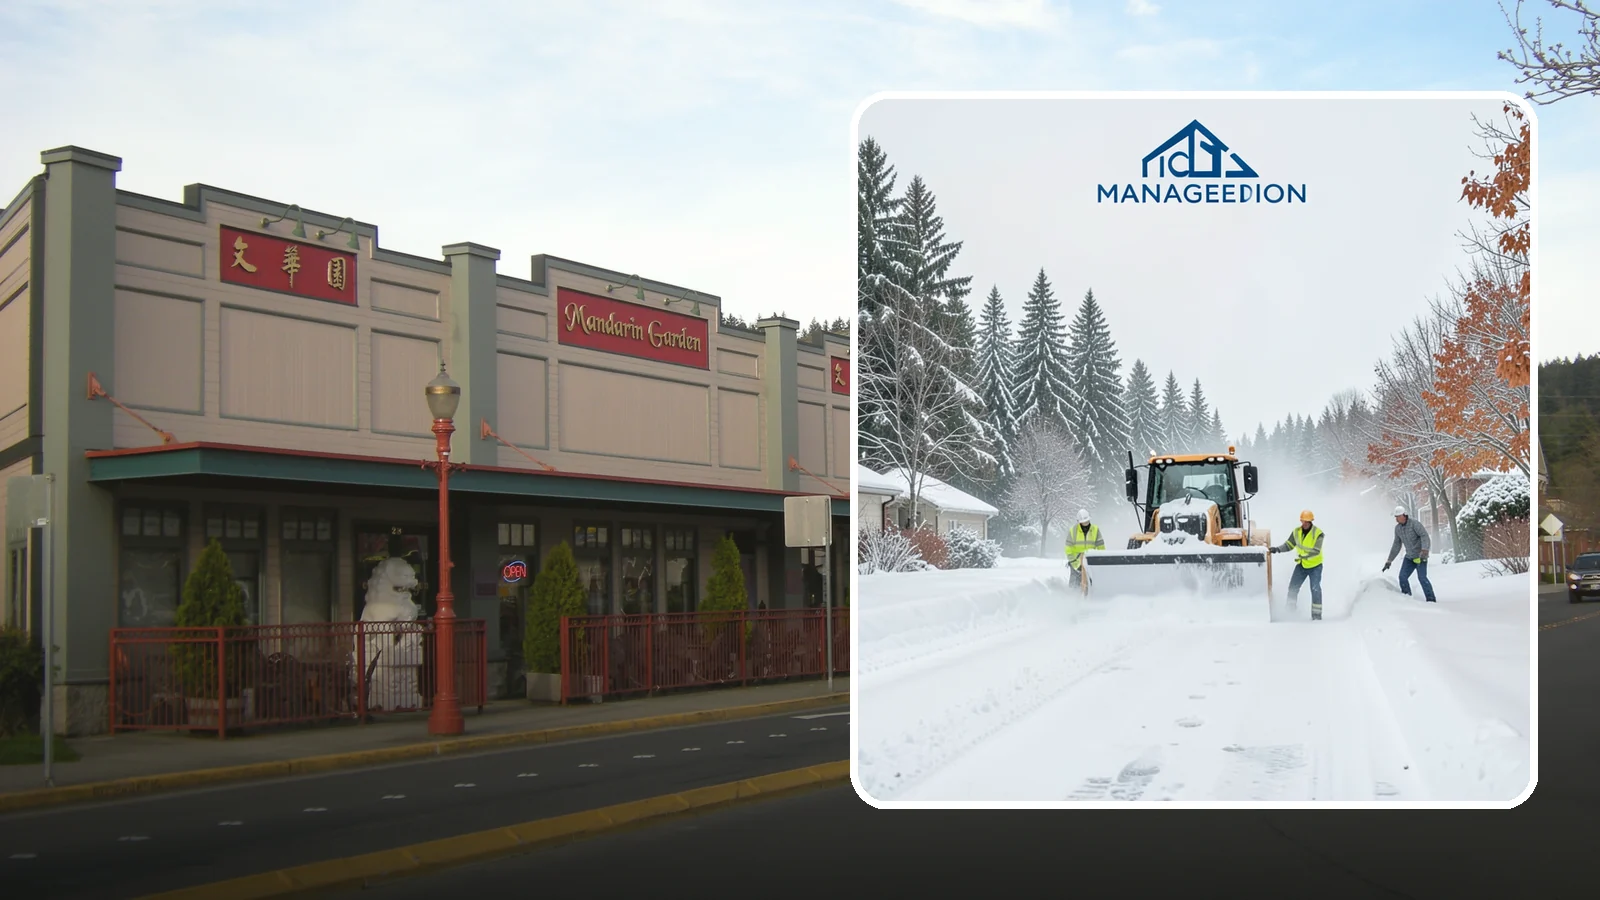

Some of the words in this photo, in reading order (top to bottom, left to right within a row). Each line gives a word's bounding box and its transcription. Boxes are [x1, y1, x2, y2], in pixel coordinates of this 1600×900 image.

[230, 235, 346, 291] 文華園
[564, 302, 644, 341] Mandarin
[648, 320, 702, 352] Garden
[503, 565, 527, 579] OPEN
